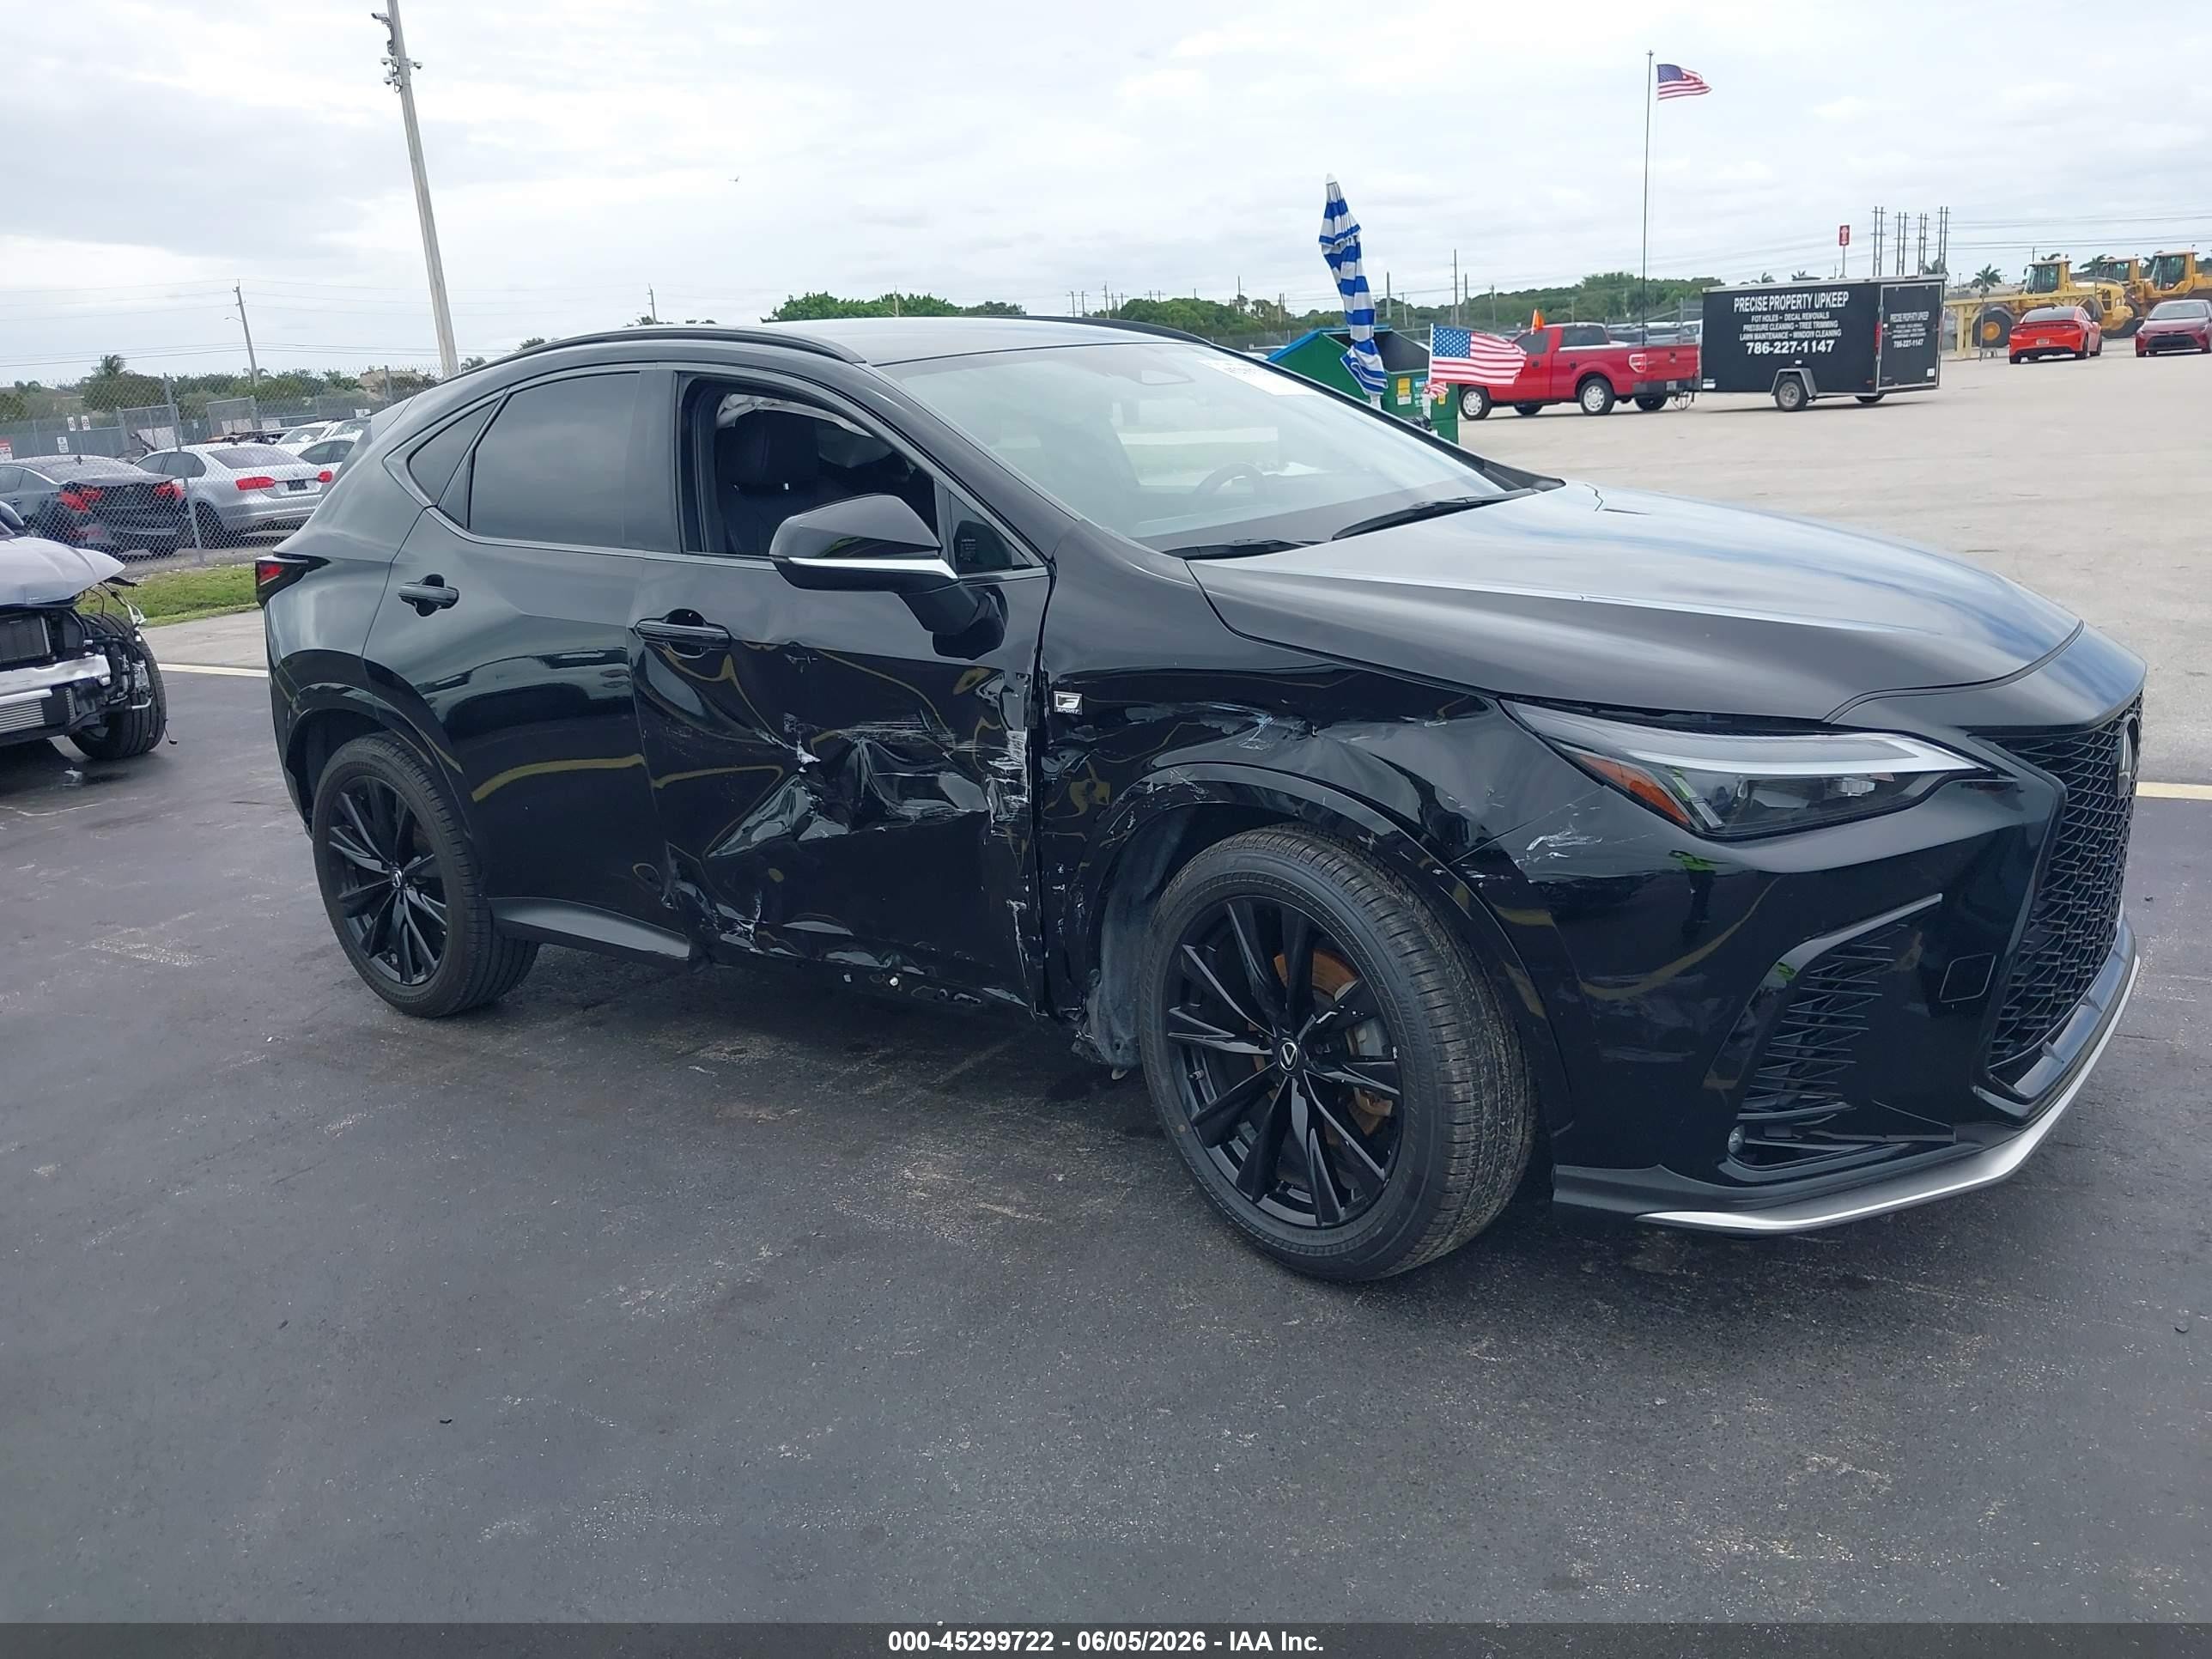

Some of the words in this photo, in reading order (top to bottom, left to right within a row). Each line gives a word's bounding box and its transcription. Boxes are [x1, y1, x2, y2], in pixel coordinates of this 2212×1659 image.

[1734, 295, 1768, 313] PRECISE
[1769, 293, 1814, 311] PROPERTY
[1814, 291, 1849, 309] UPKEEP
[1746, 339, 1835, 355] 786-227-1147
